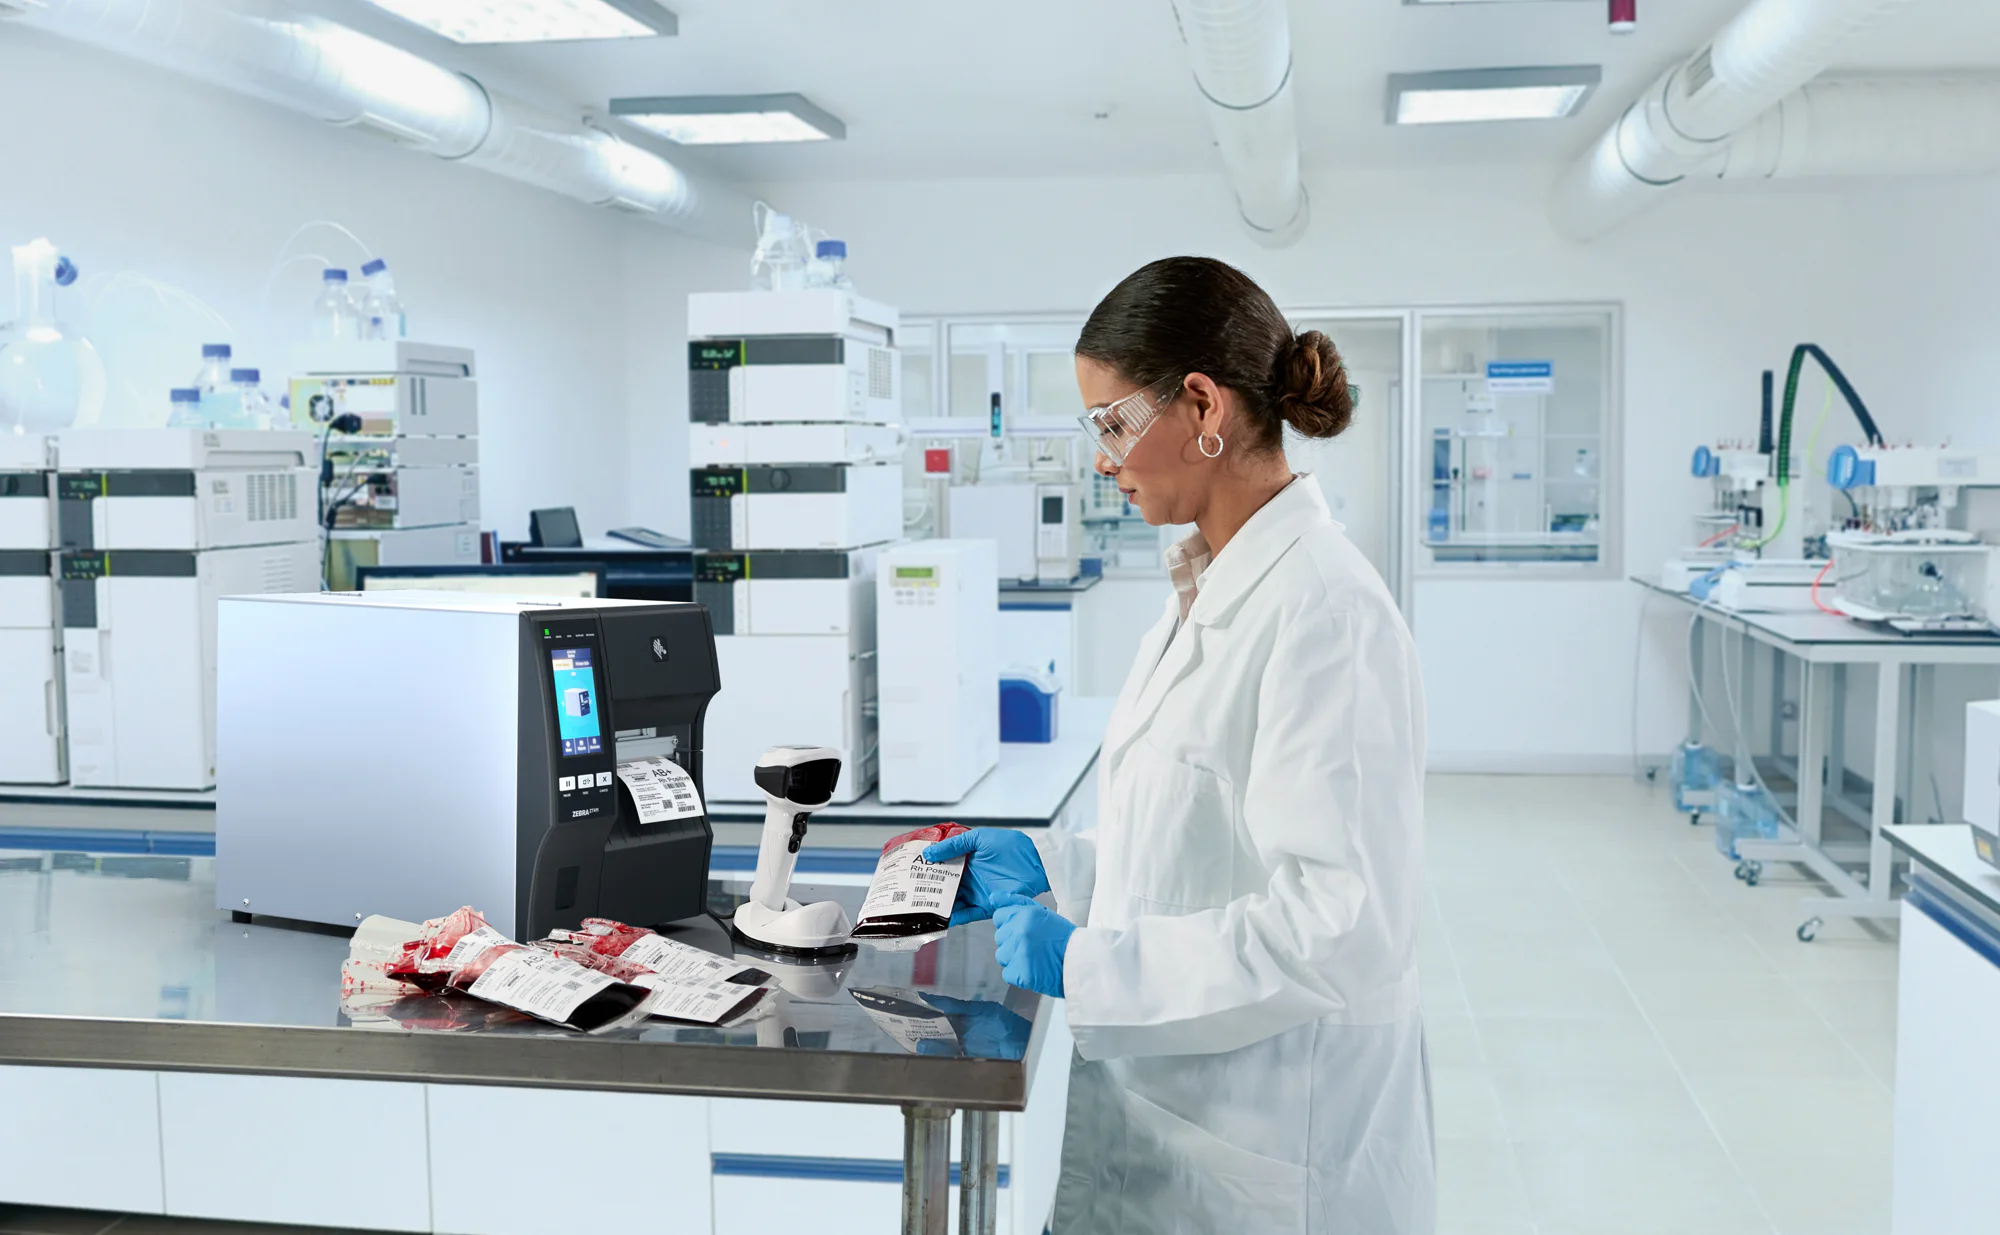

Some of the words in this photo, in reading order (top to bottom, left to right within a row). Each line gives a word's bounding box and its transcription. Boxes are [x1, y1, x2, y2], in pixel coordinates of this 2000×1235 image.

[652, 768, 672, 778] AB+
[572, 809, 590, 818] ZEBRA
[925, 867, 960, 877] Positive
